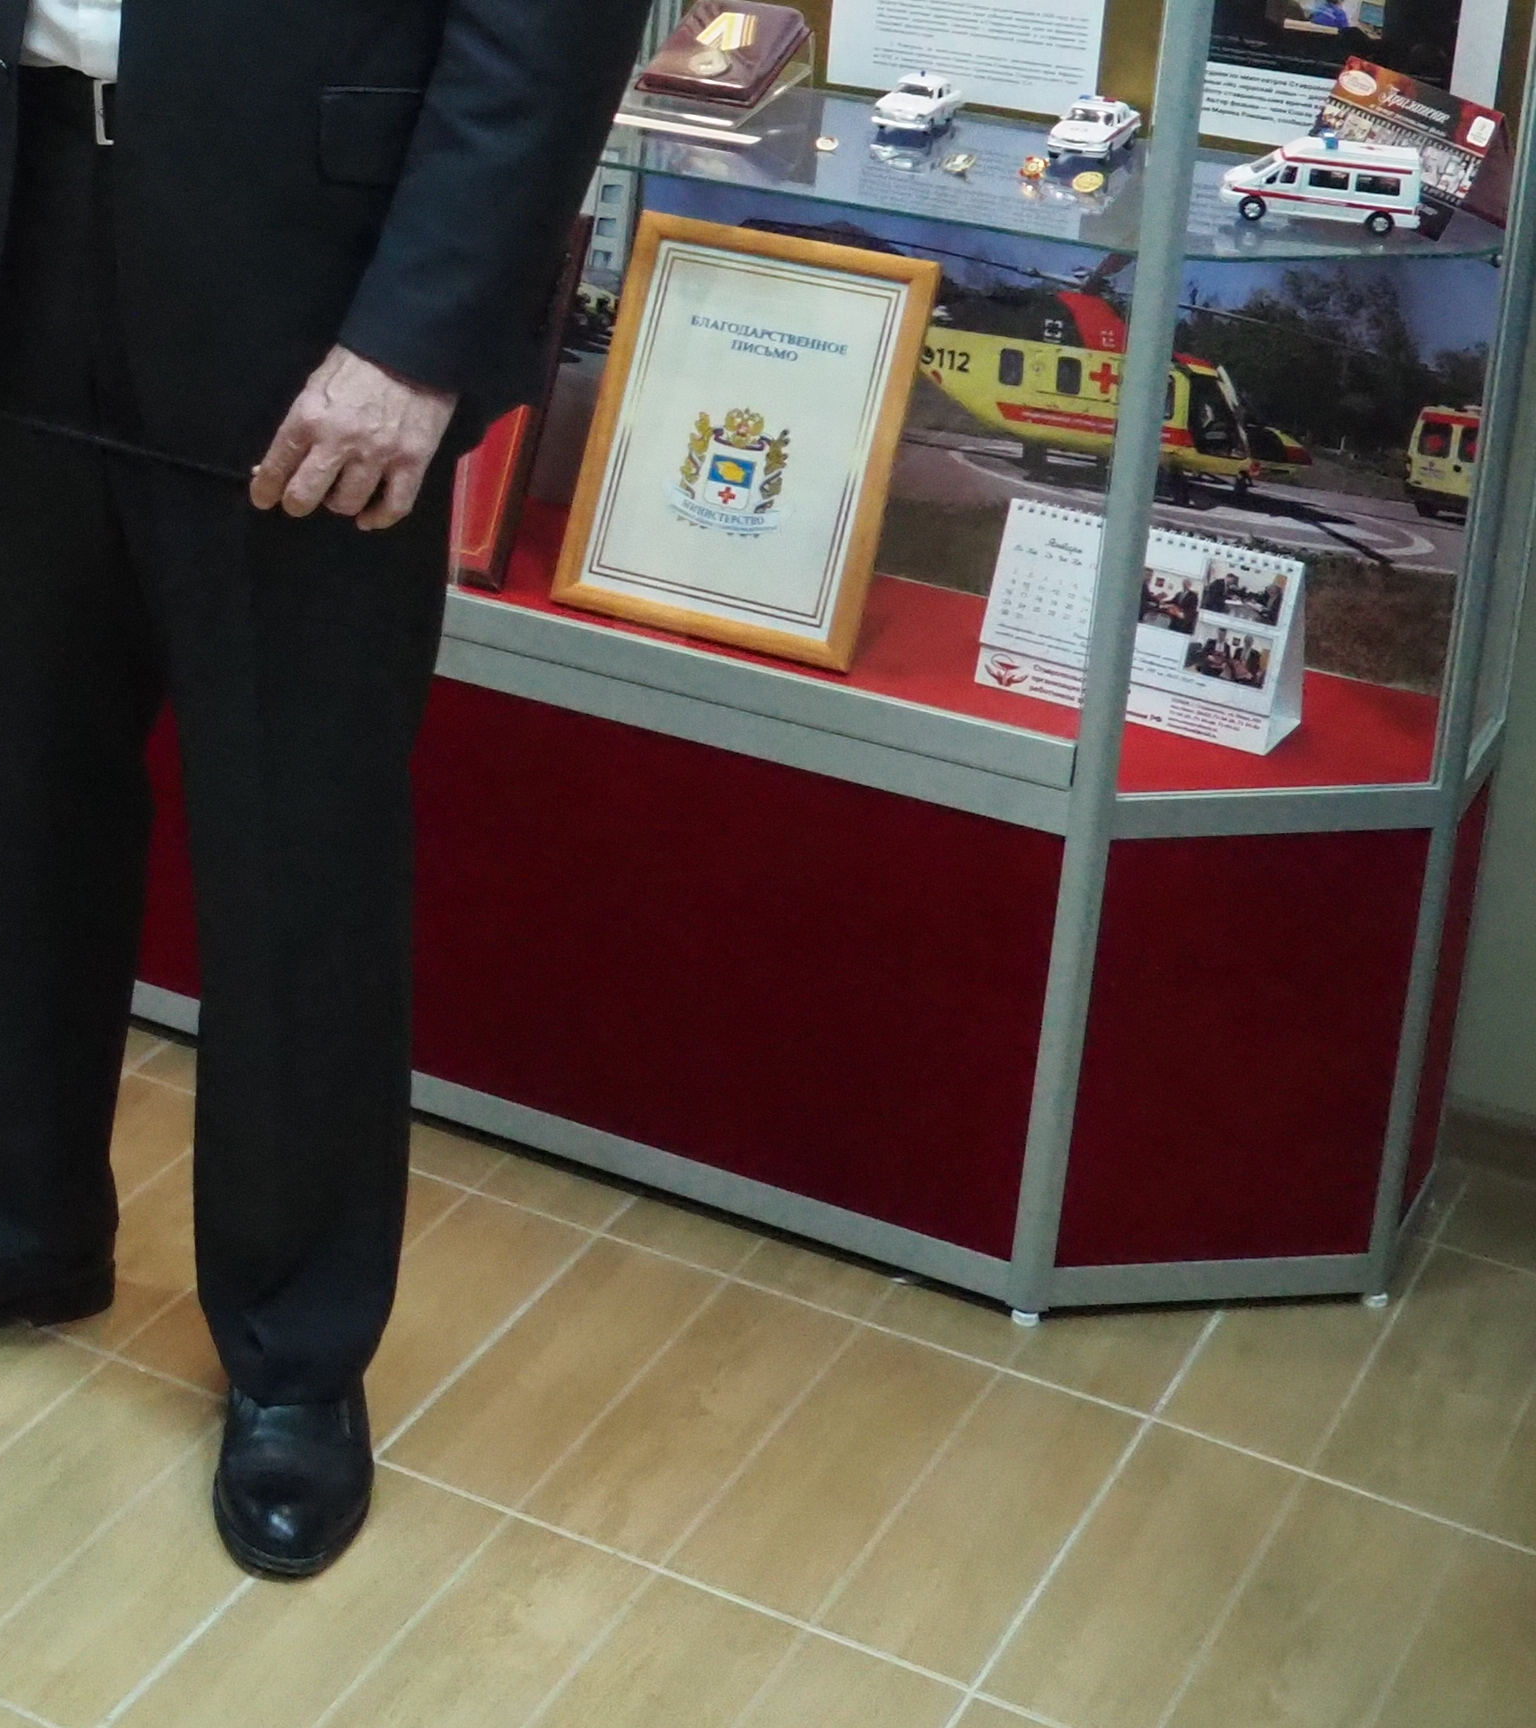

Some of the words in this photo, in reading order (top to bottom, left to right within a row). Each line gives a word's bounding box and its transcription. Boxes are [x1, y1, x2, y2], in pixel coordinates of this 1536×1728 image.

[690, 314, 849, 356] БЛАГОДАРСТВЕННОЕ
[730, 338, 799, 362] ПИСЬМО
[936, 348, 971, 373] 112
[681, 498, 765, 525] МИНИСТЕРСТВО
